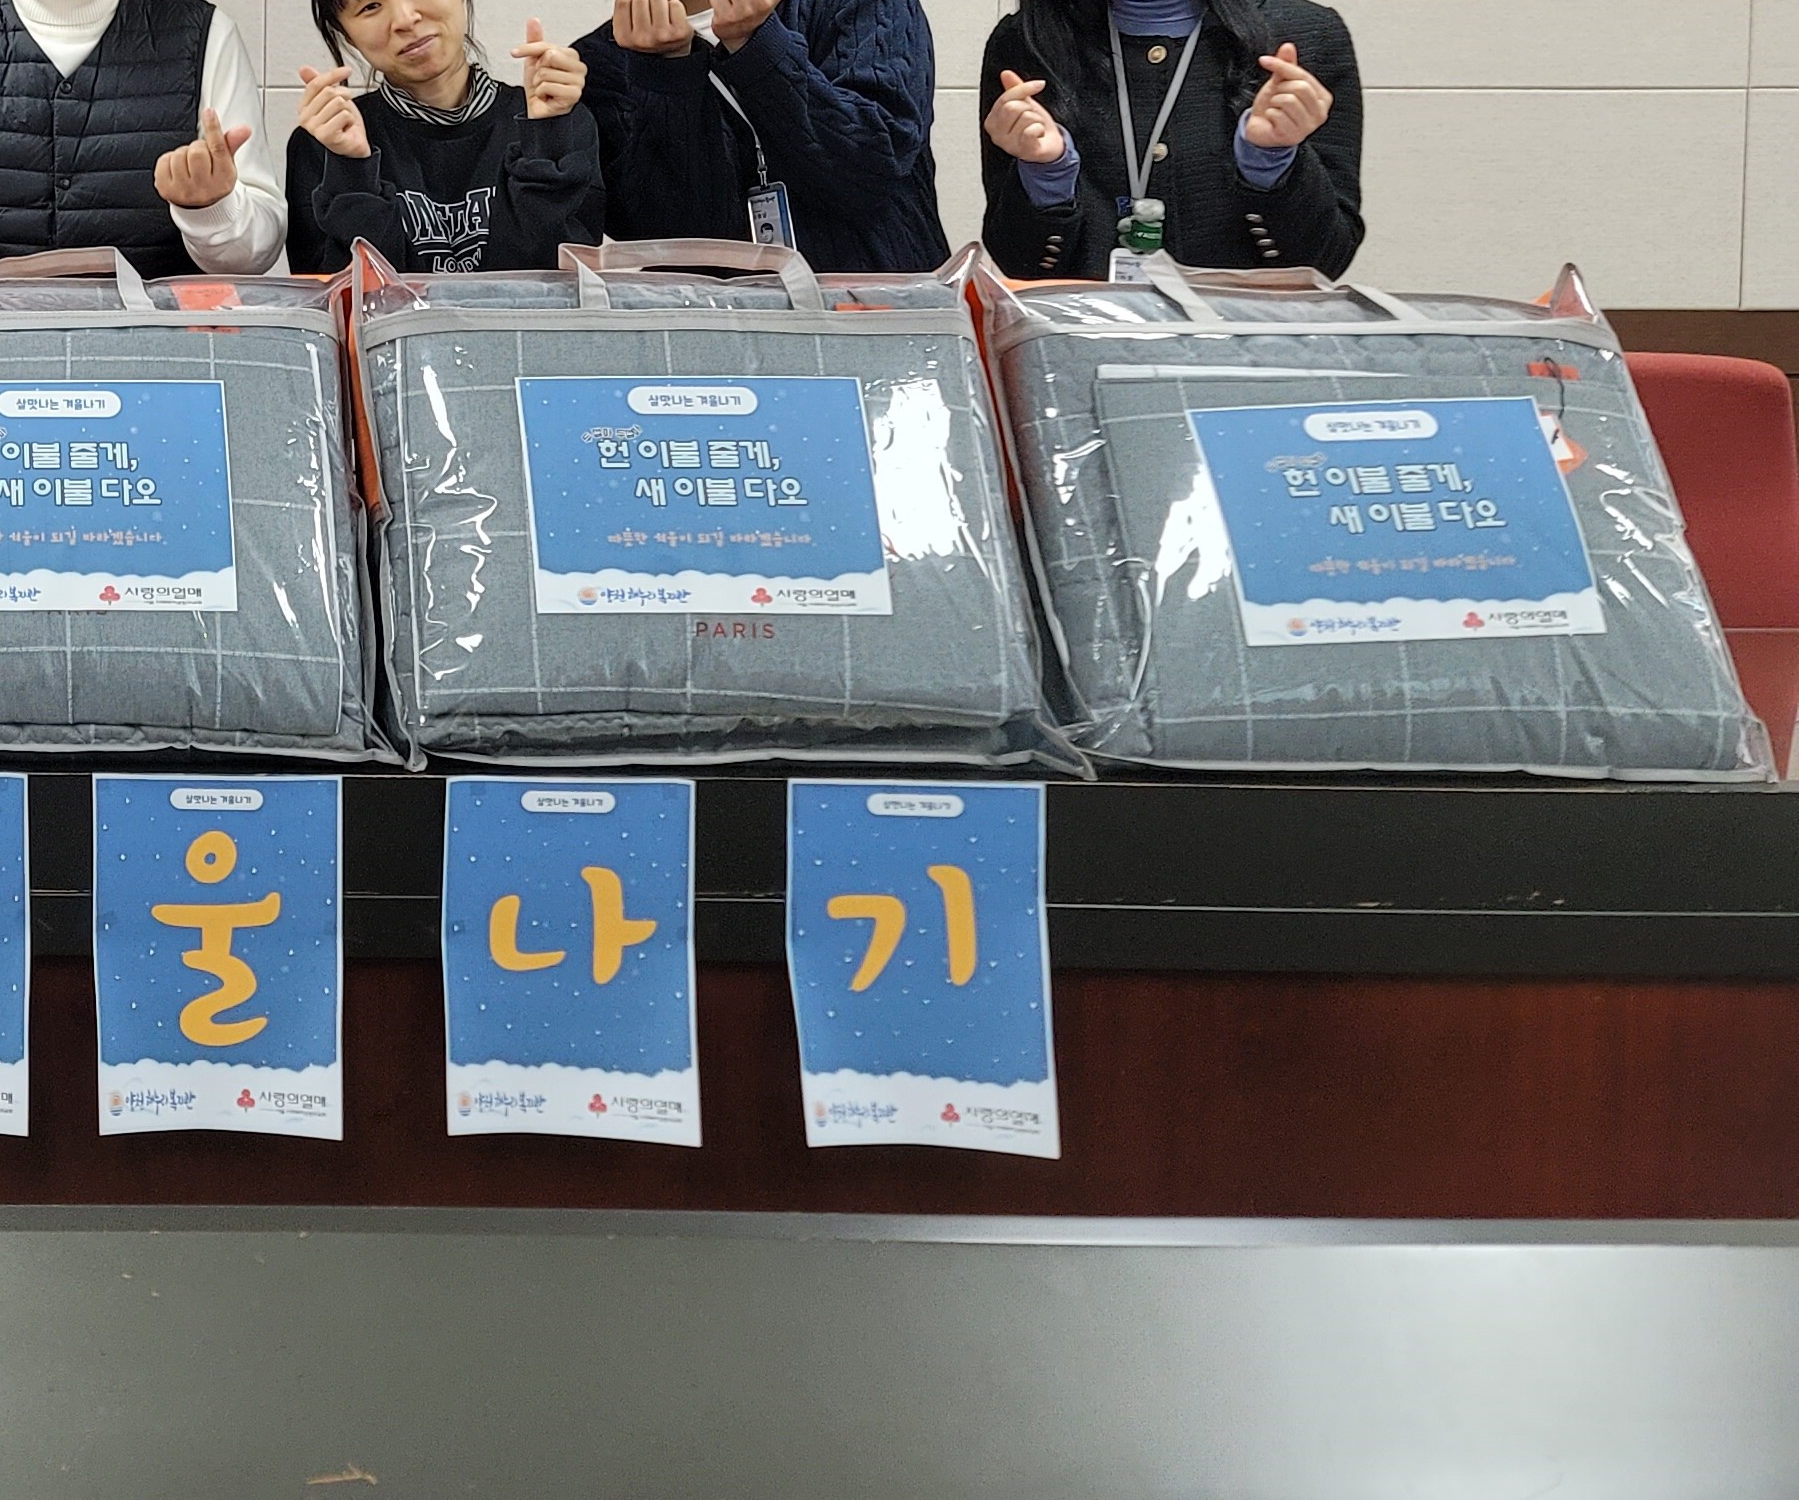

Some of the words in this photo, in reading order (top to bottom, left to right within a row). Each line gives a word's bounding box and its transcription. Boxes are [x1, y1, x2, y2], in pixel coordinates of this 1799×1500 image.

[16, 398, 59, 410] 살맛나는
[63, 398, 105, 410] 겨울나기
[696, 396, 741, 407] 겨울나기
[1, 442, 61, 470] 이불
[69, 442, 139, 472] 줄게,
[598, 440, 632, 469] 헌
[637, 441, 700, 469] 이불
[707, 441, 780, 471] 줄게,
[33, 479, 93, 507] 이불
[101, 478, 162, 507] 다오
[635, 477, 667, 507] 새
[672, 478, 738, 507] 이불
[743, 477, 808, 507] 다오
[1281, 466, 1321, 498] 헌
[1326, 466, 1393, 495] 이불
[1396, 465, 1473, 493] 줄게,
[1328, 505, 1366, 535] 새
[1367, 503, 1437, 532] 이불
[1439, 500, 1508, 529] 다오
[125, 586, 202, 600] 사랑의열매
[696, 622, 776, 639] PARIS
[151, 830, 281, 1046] 울
[489, 866, 657, 985] 나
[826, 864, 977, 992] 기
